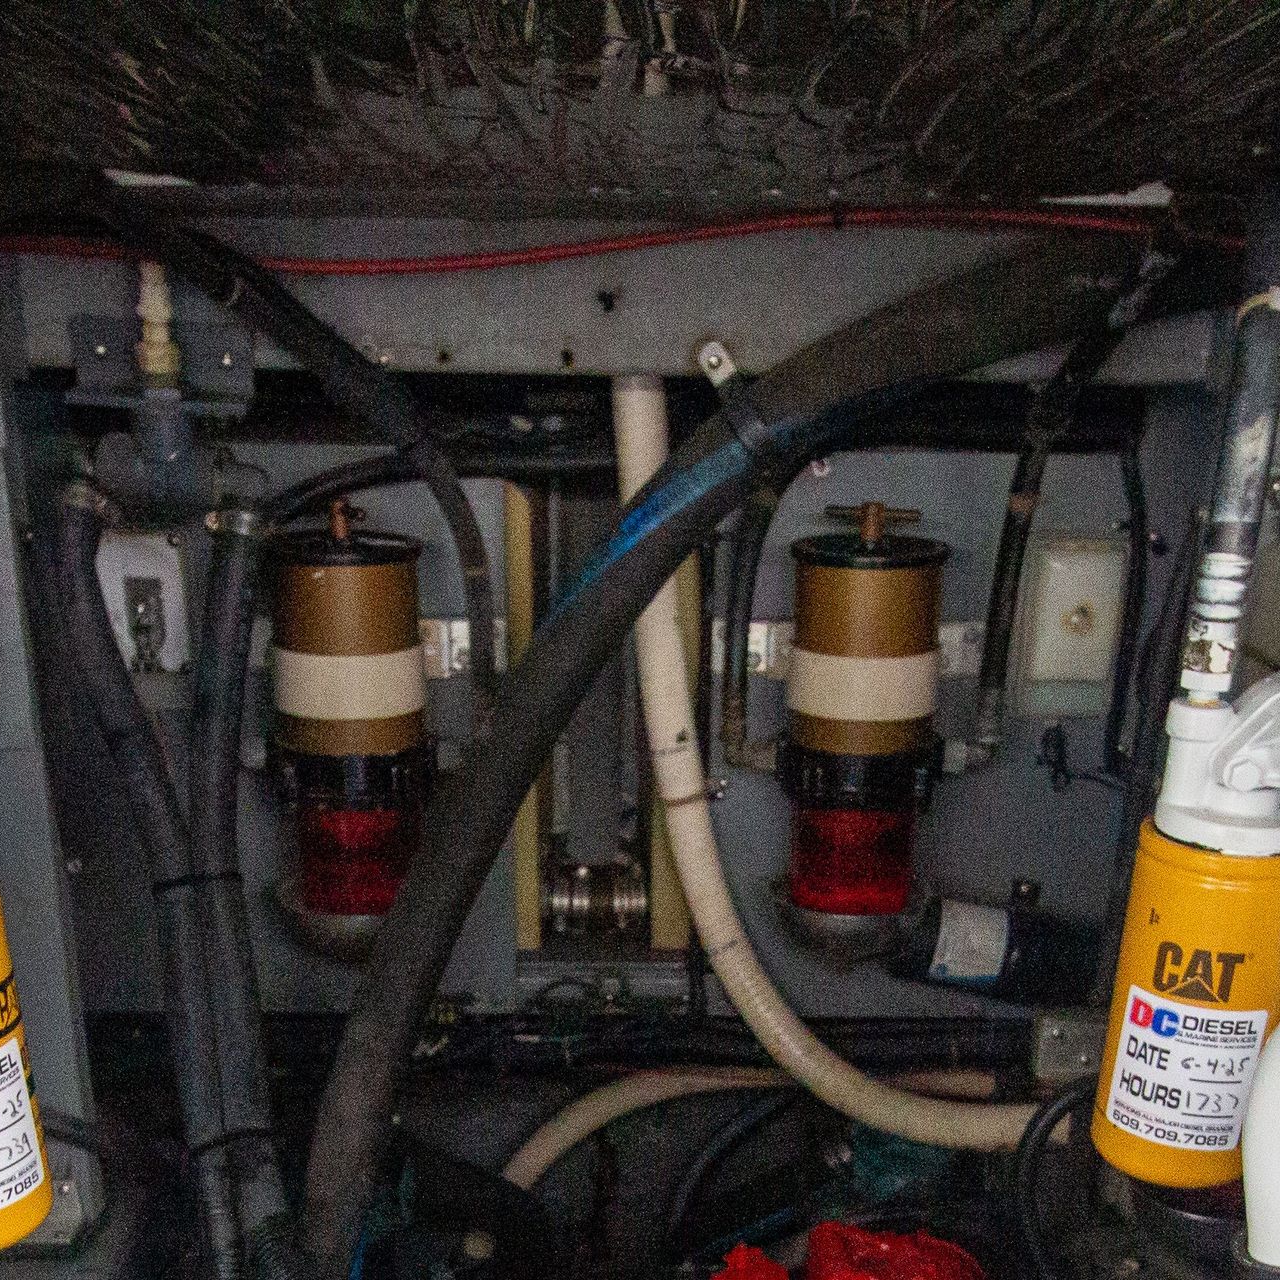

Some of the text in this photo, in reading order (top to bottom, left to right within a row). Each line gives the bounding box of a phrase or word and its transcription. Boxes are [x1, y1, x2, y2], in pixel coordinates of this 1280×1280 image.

[1153, 939, 1246, 1003] CAT
[1128, 996, 1258, 1038] DC DIESEL
[1126, 1034, 1171, 1071] DATE
[1119, 1068, 1182, 1110] HOURS
[1112, 1109, 1229, 1147] 609.709.7085
